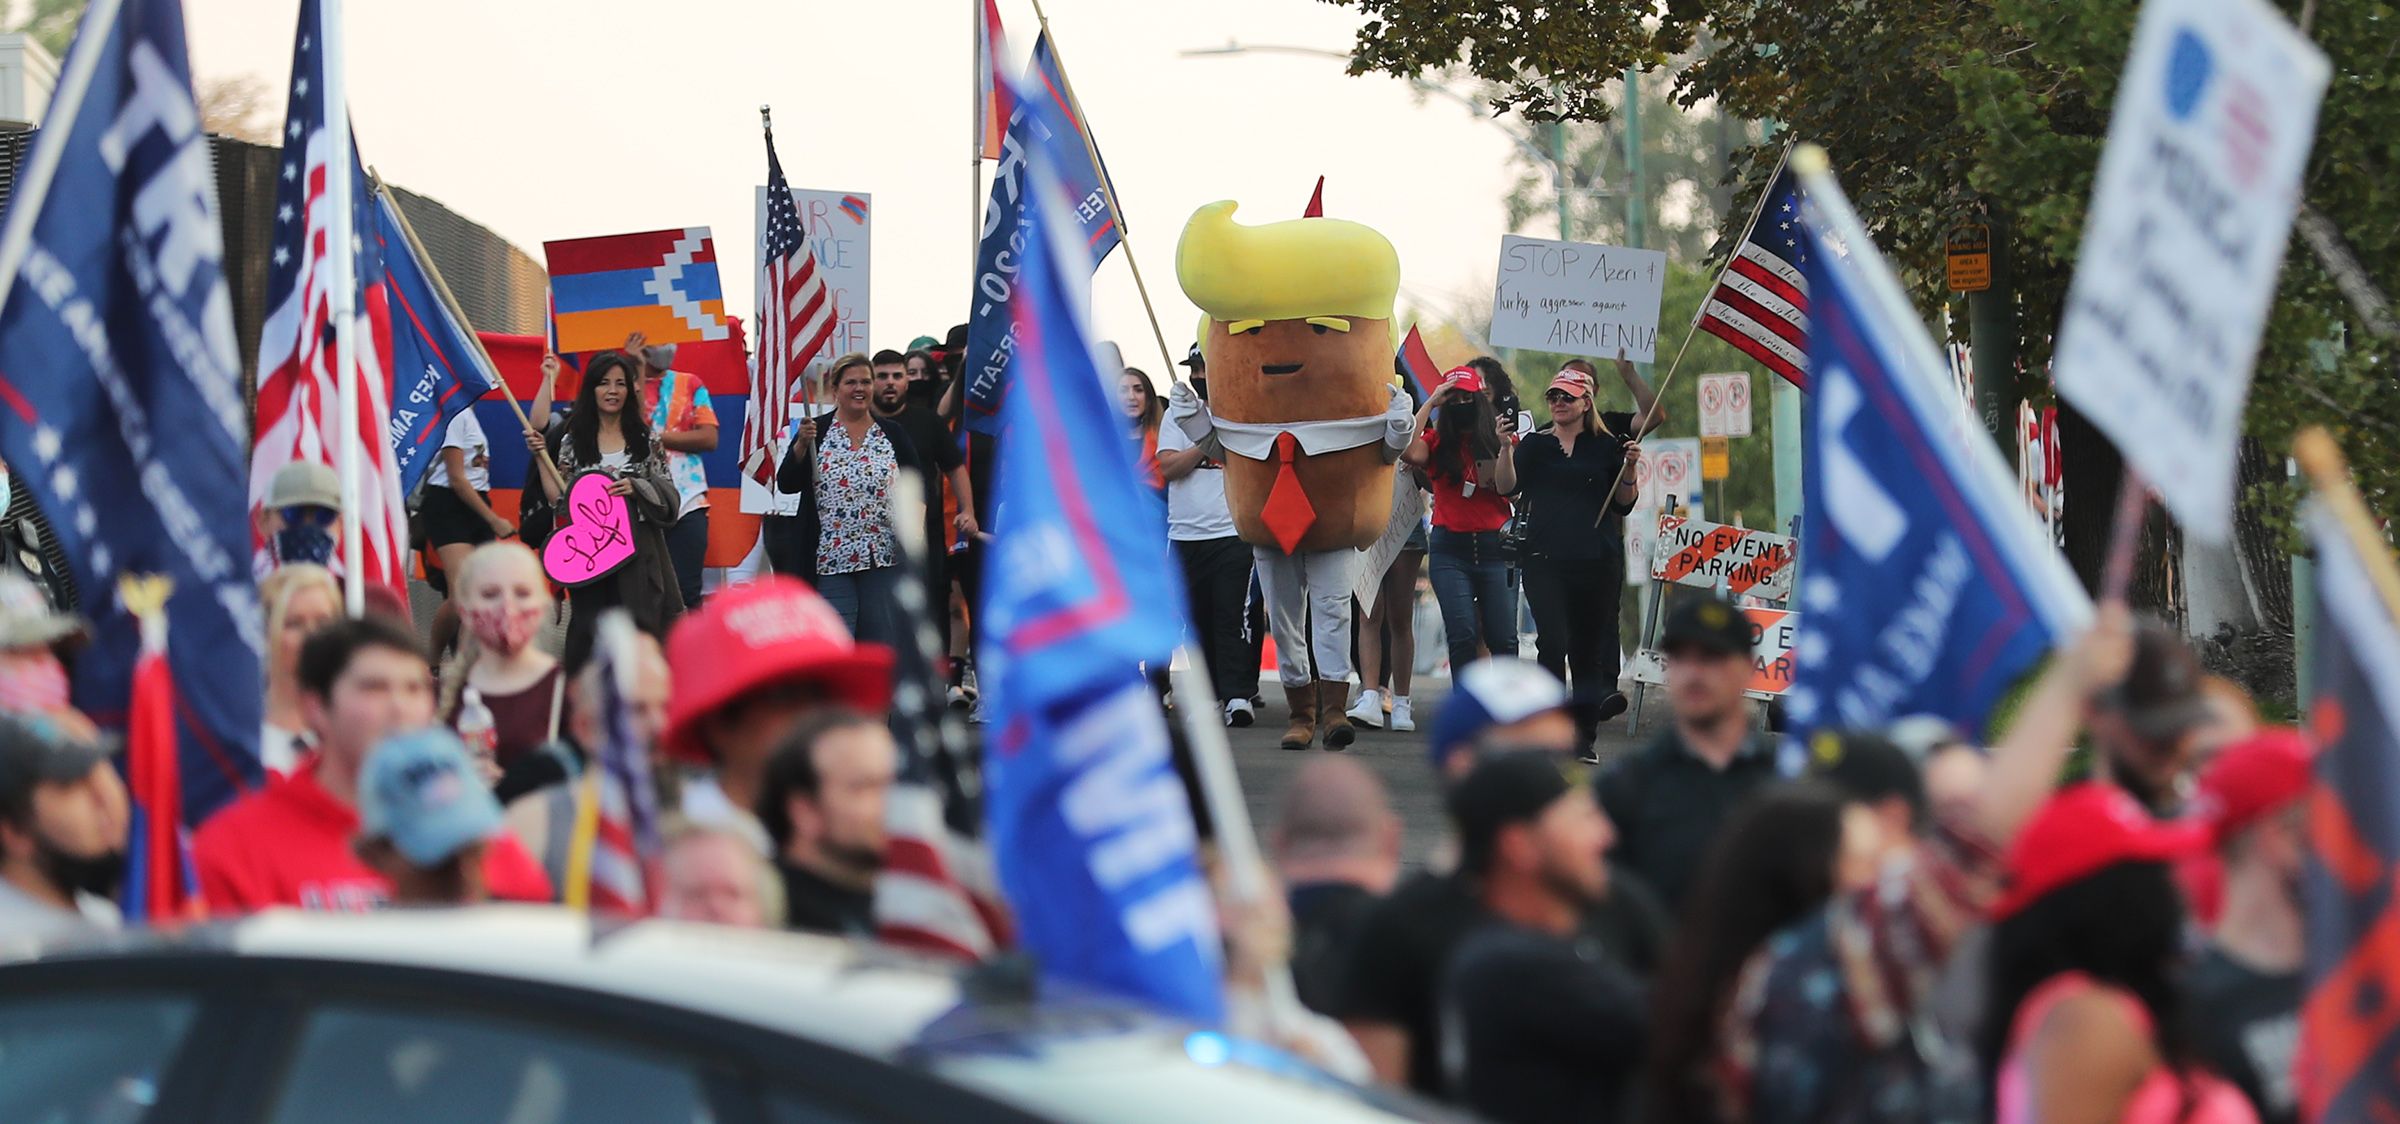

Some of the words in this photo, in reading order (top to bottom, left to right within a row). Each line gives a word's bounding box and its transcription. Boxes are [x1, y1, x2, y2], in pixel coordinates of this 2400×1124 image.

[1504, 243, 1580, 278] STOP
[1589, 253, 1637, 284] Azeri
[1753, 252, 1768, 265] to
[1777, 265, 1801, 286] the
[1719, 306, 1746, 329] bear
[1736, 280, 1758, 298] the
[1765, 298, 1801, 323] right
[1546, 318, 1658, 353] ARMENIA
[1675, 527, 1705, 549] NO
[1713, 534, 1784, 562] EVENT
[1679, 552, 1773, 586] PARKING
[1751, 622, 1765, 646] O
[1778, 626, 1794, 650] E
[1752, 654, 1791, 682] AR
